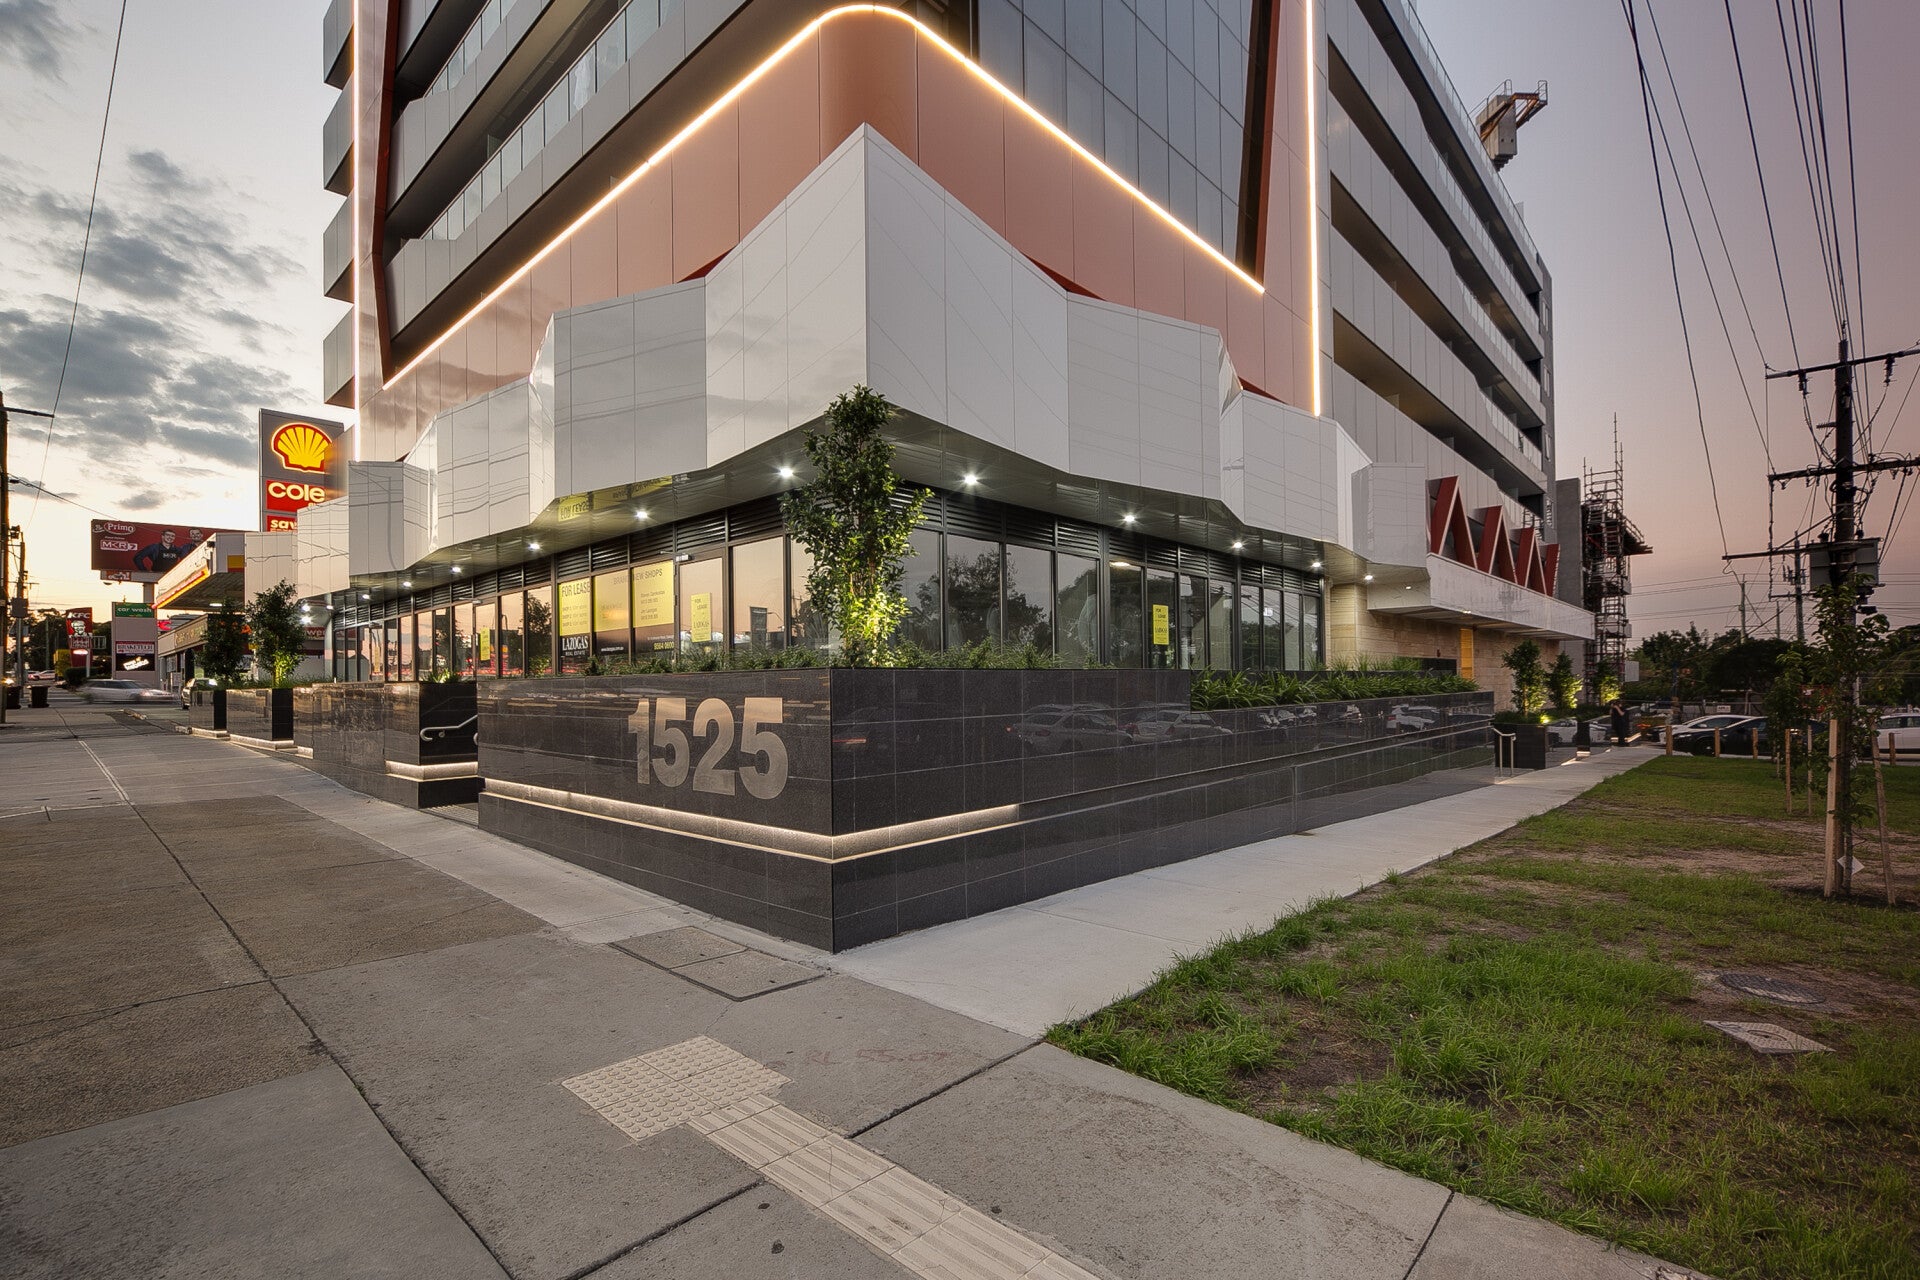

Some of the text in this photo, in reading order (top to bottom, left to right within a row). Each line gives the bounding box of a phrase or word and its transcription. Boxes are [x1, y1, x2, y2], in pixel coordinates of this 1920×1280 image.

[107, 523, 134, 533] Primo
[561, 581, 591, 597] FOR LEASE
[562, 635, 589, 651] LAZOGAS
[628, 697, 788, 800] 1525
